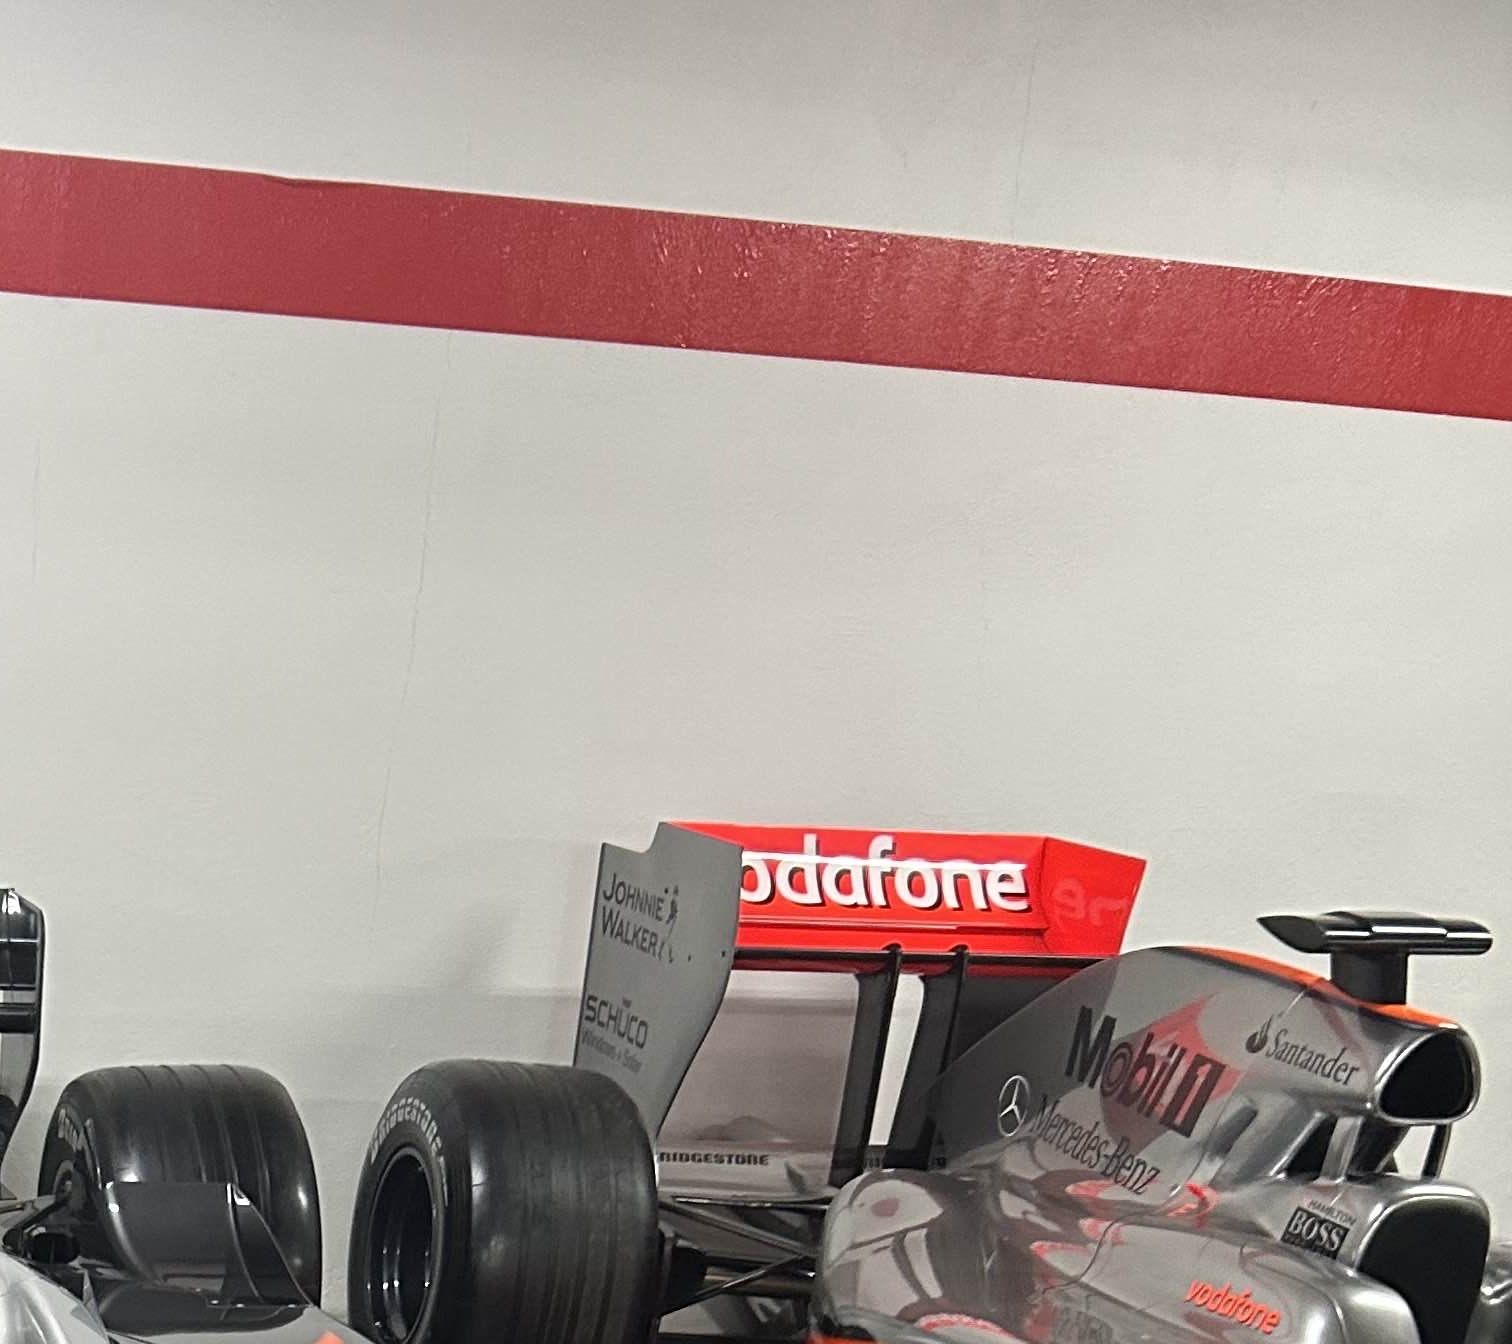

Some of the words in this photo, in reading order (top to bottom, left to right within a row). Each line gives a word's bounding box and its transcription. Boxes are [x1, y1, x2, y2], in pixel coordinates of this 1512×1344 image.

[603, 873, 664, 922] JOHNNIE
[741, 833, 1029, 912] odafone
[602, 906, 661, 960] WALKER
[1265, 1028, 1360, 1086] Santander
[658, 1151, 769, 1166] RIDGESTONE
[1029, 1095, 1161, 1196] Mercedes-Benz
[1288, 1210, 1345, 1252] BOSS
[1184, 1280, 1282, 1335] vodafone
